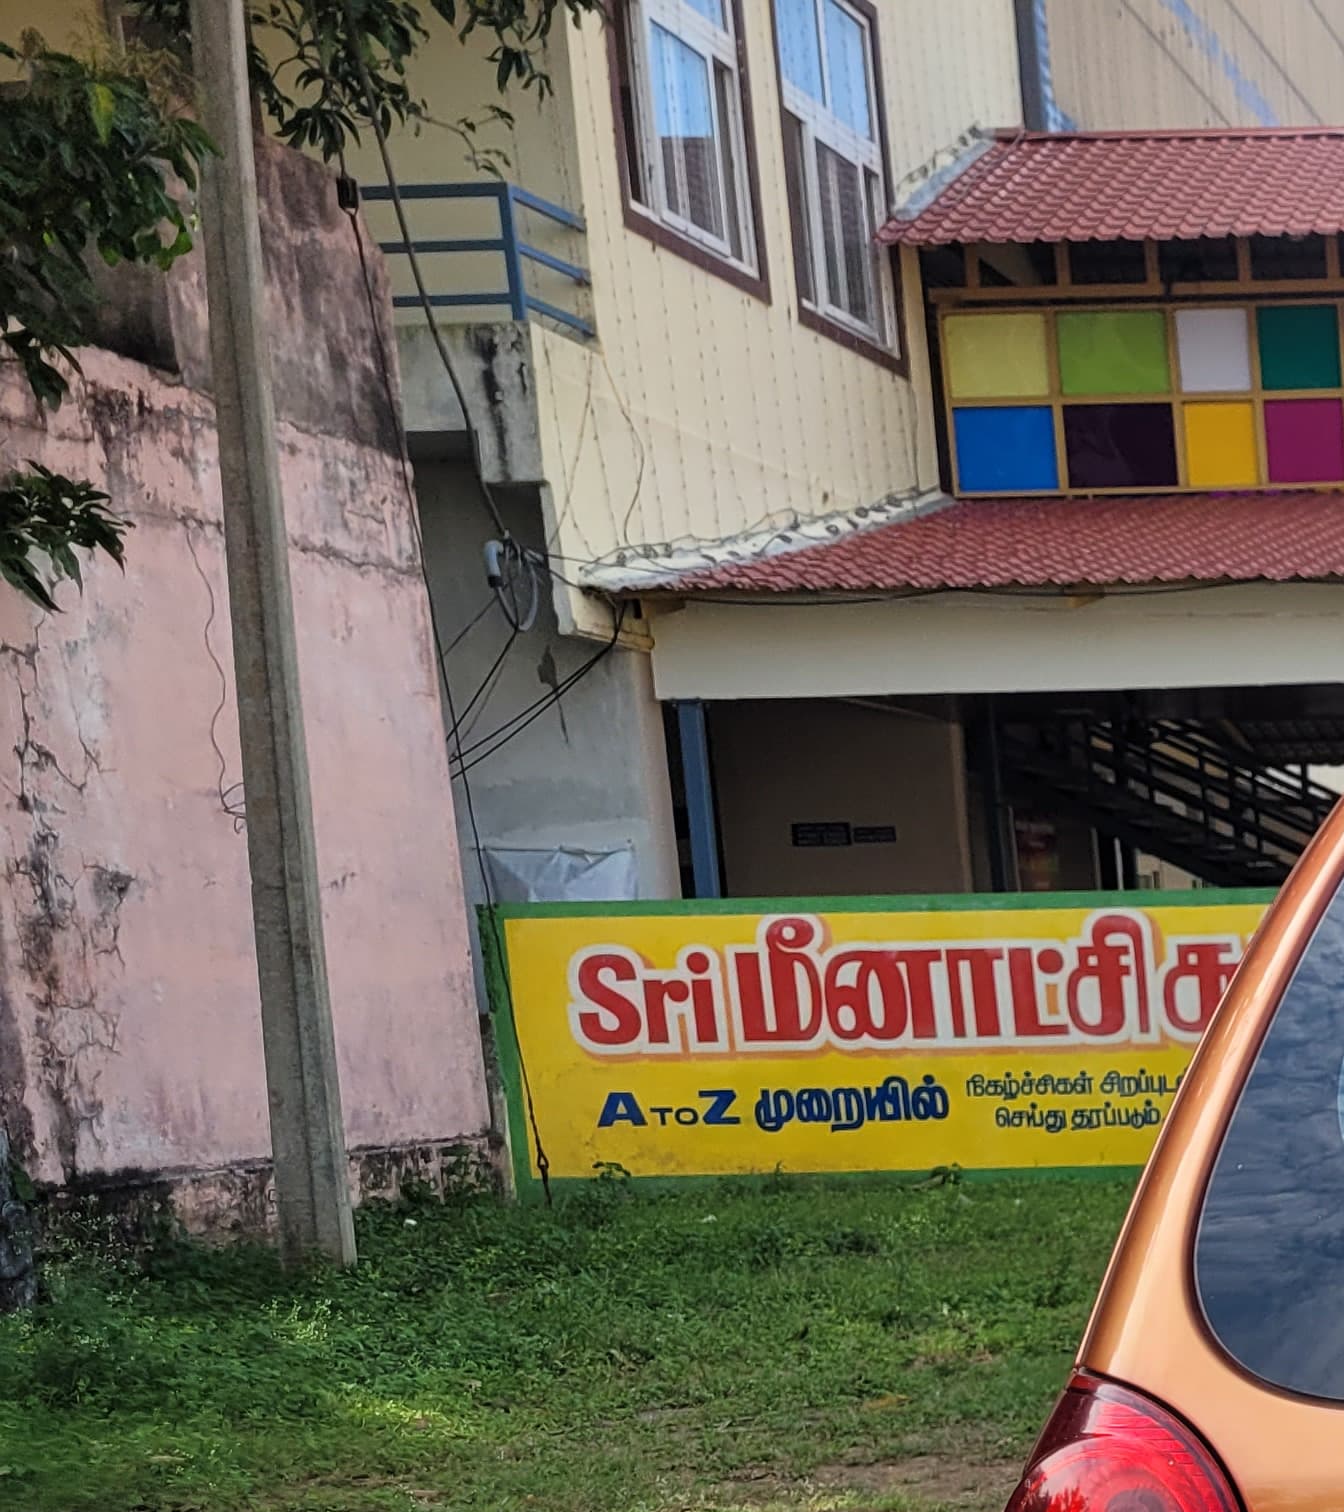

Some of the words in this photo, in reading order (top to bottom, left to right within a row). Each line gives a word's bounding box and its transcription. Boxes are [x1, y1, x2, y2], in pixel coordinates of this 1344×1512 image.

[576, 949, 719, 1045] Sri
[733, 916, 1150, 1042] மீனாட்சி
[755, 1074, 950, 1133] முறையில்
[966, 1070, 1094, 1100] நிகழ்ச்சிகள்
[995, 1102, 1067, 1133] செய்து
